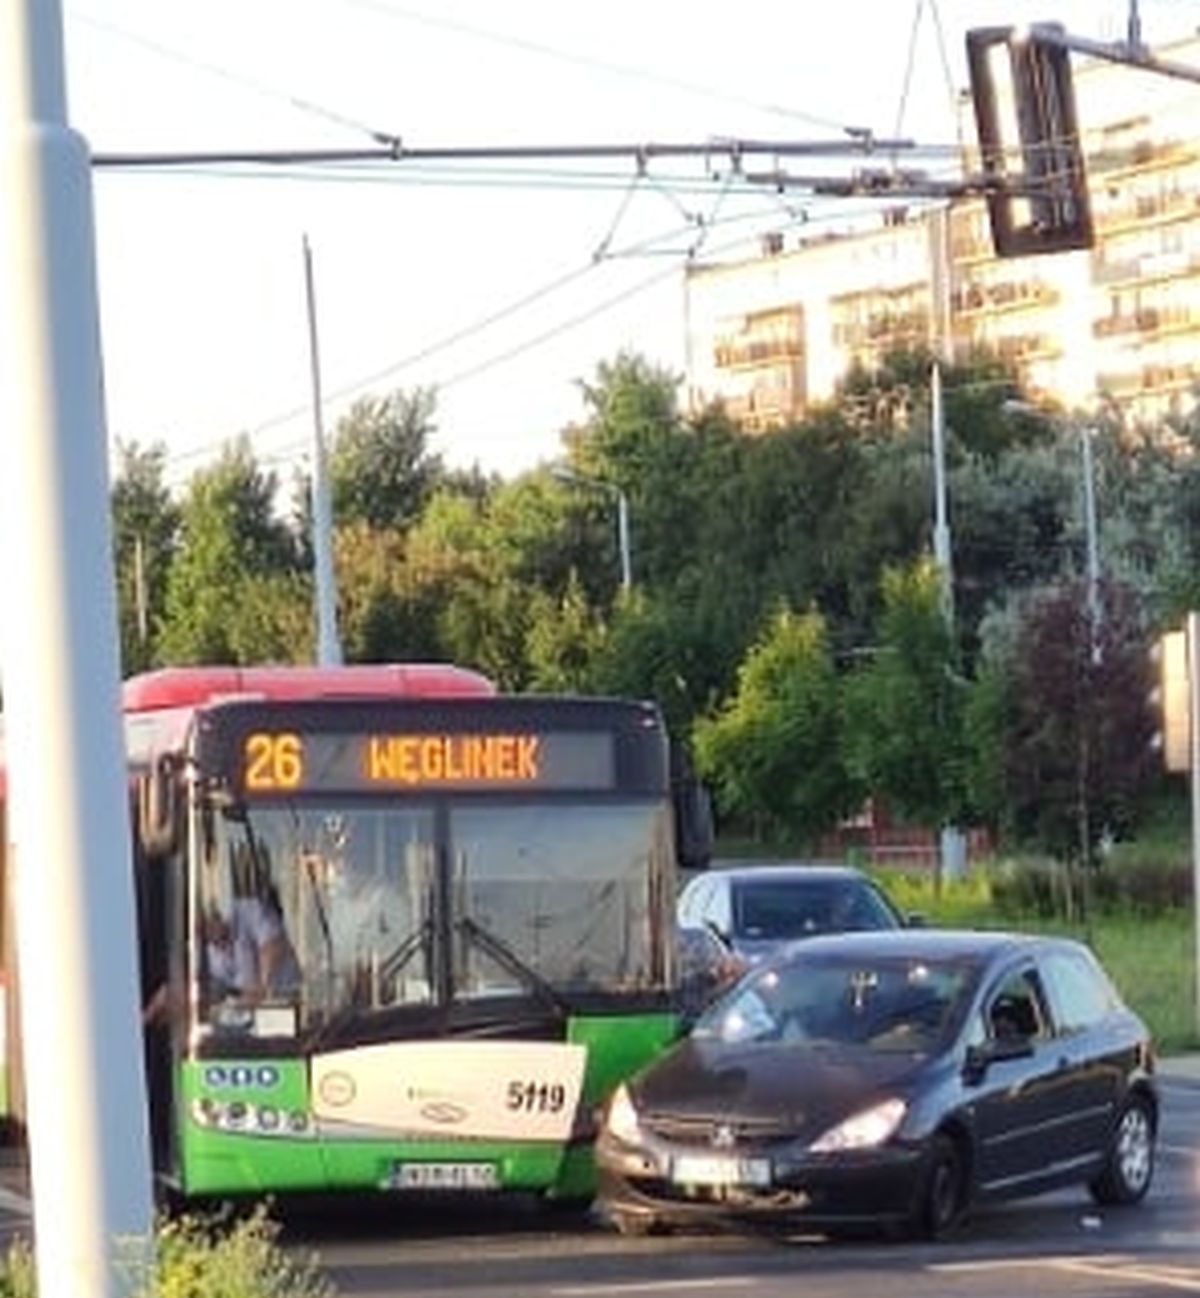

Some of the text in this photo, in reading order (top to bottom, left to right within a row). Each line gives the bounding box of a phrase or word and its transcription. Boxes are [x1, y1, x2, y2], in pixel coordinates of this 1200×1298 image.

[245, 733, 539, 788] 26 WĘGLINEK
[506, 1080, 567, 1113] 5119
